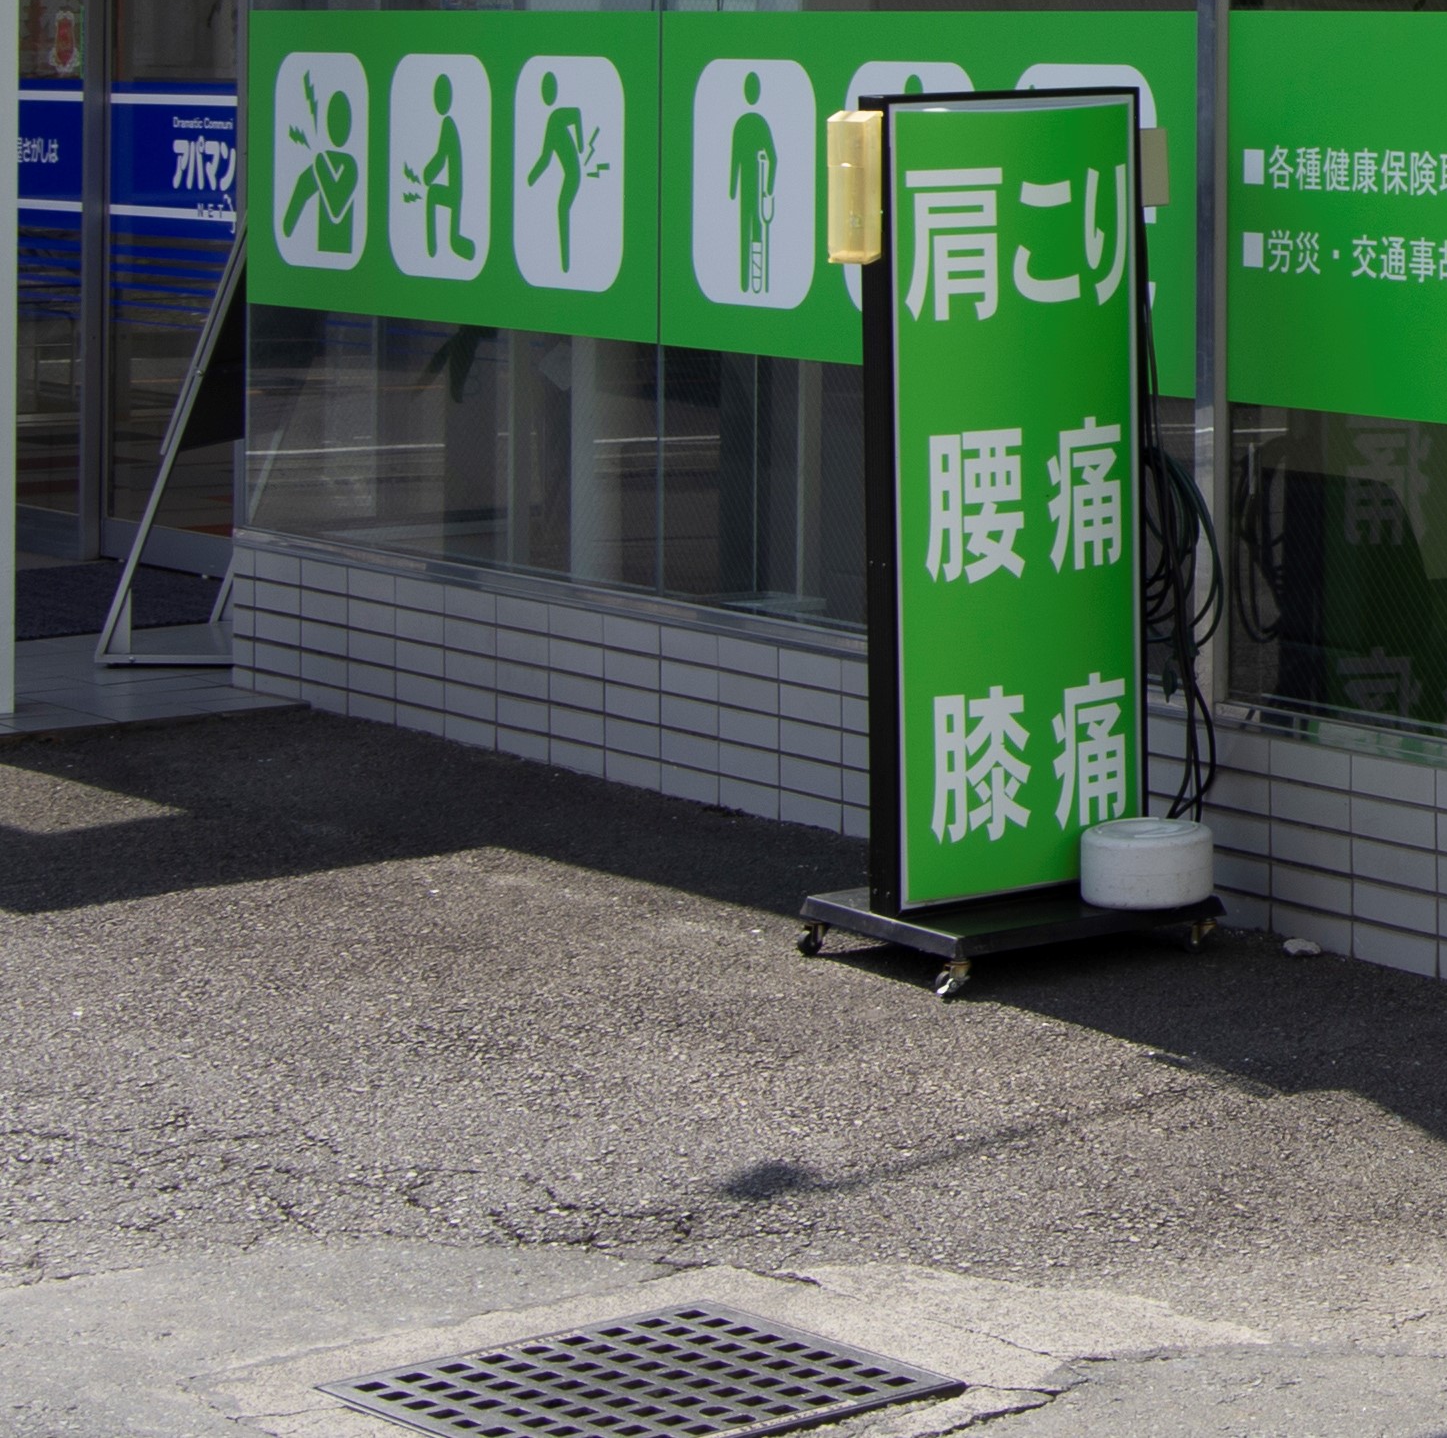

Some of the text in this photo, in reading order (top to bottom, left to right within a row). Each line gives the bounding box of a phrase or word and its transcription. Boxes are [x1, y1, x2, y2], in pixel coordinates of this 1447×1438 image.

[904, 162, 1132, 322] 肩こり
[924, 416, 1122, 584] 腰痛
[930, 672, 1128, 845] 膝痛
